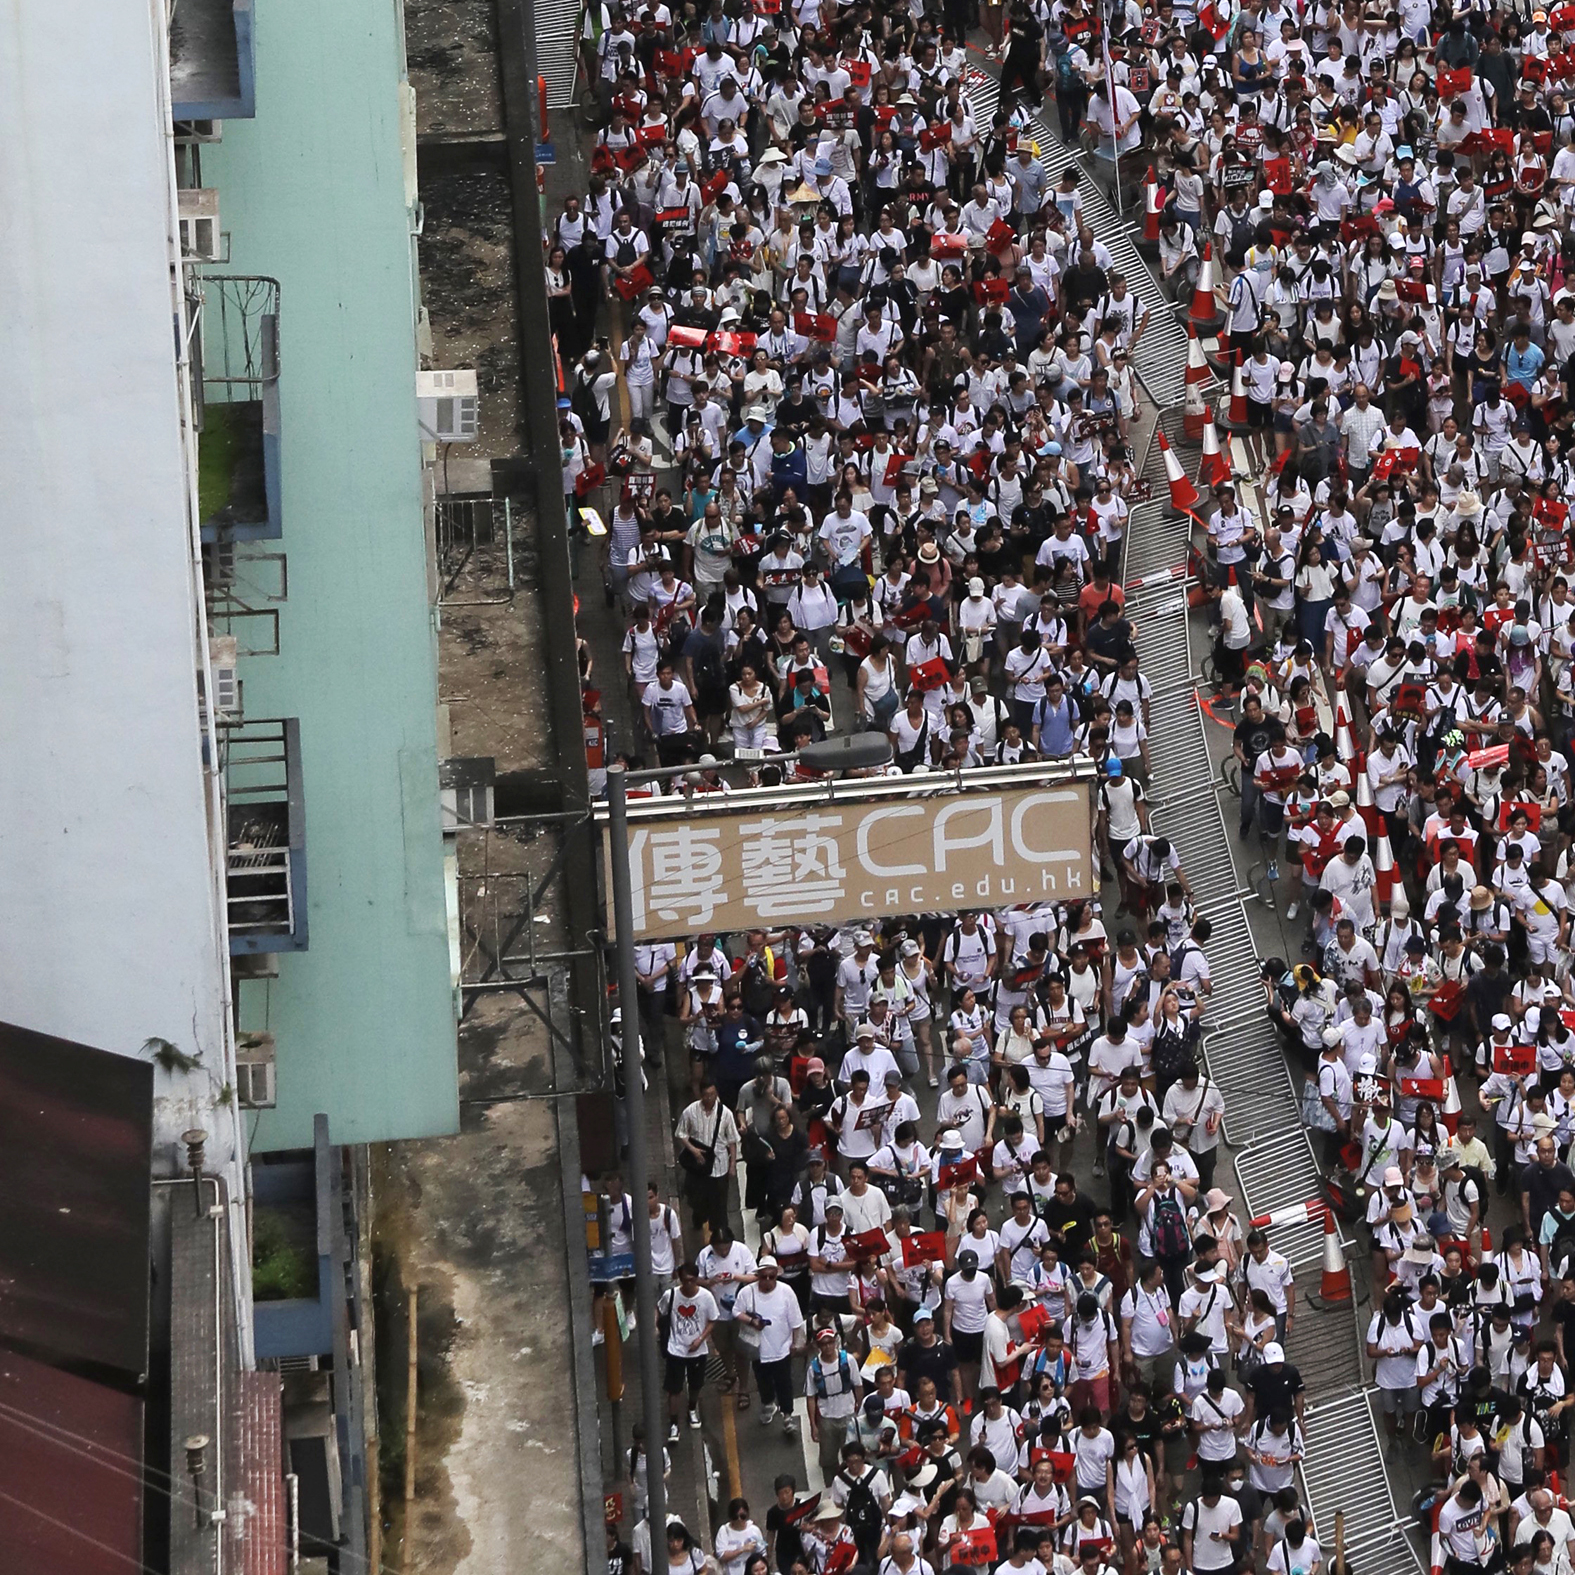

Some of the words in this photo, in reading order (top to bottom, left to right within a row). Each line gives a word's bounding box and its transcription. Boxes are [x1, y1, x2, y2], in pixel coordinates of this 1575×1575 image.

[907, 193, 929, 201] RMY
[629, 814, 847, 931] 傳藝
[856, 790, 1082, 877] CAC
